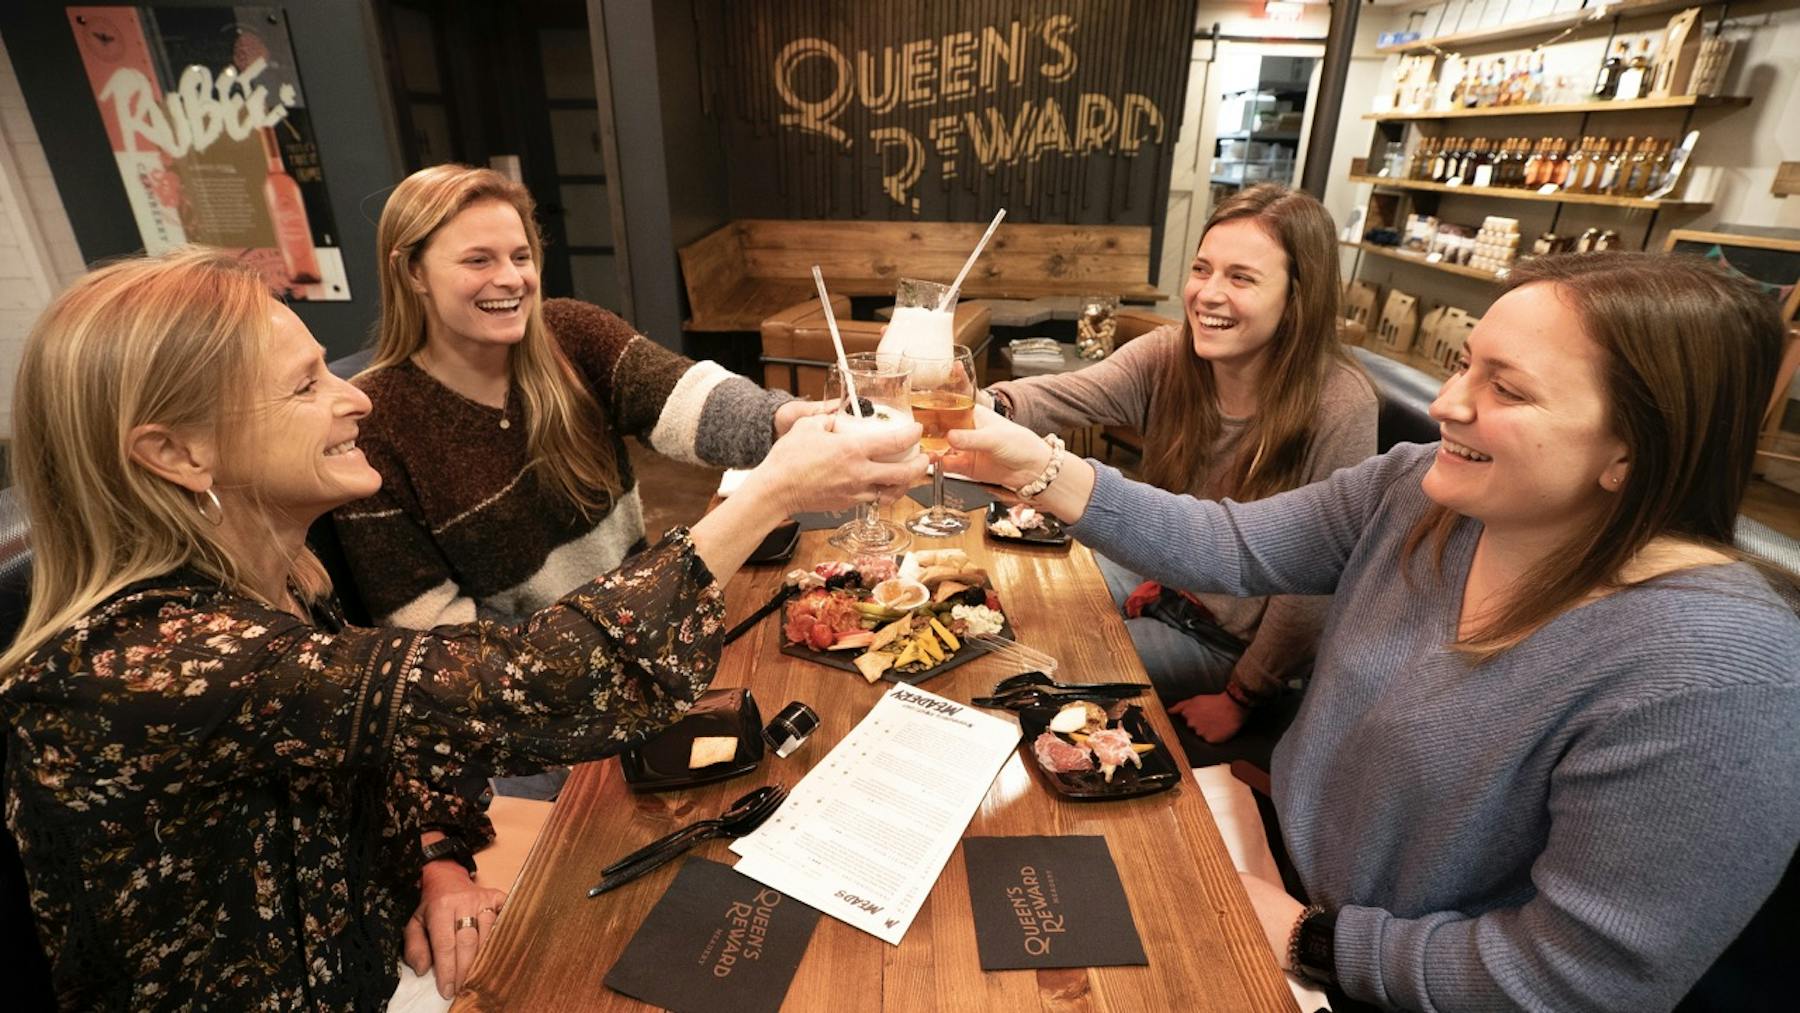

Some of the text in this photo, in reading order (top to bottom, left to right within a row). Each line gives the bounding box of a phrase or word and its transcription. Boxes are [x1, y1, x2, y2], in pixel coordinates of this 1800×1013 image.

[774, 13, 1079, 149] QUEEN'S
[869, 93, 1165, 214] REWARD
[890, 689, 964, 716] MEADERY
[743, 888, 782, 961] QUEEN'S
[834, 889, 885, 915] MEADS
[1006, 886, 1050, 956] QUEEN'S
[1020, 865, 1067, 933] REWARD
[713, 901, 753, 978] REWARD
